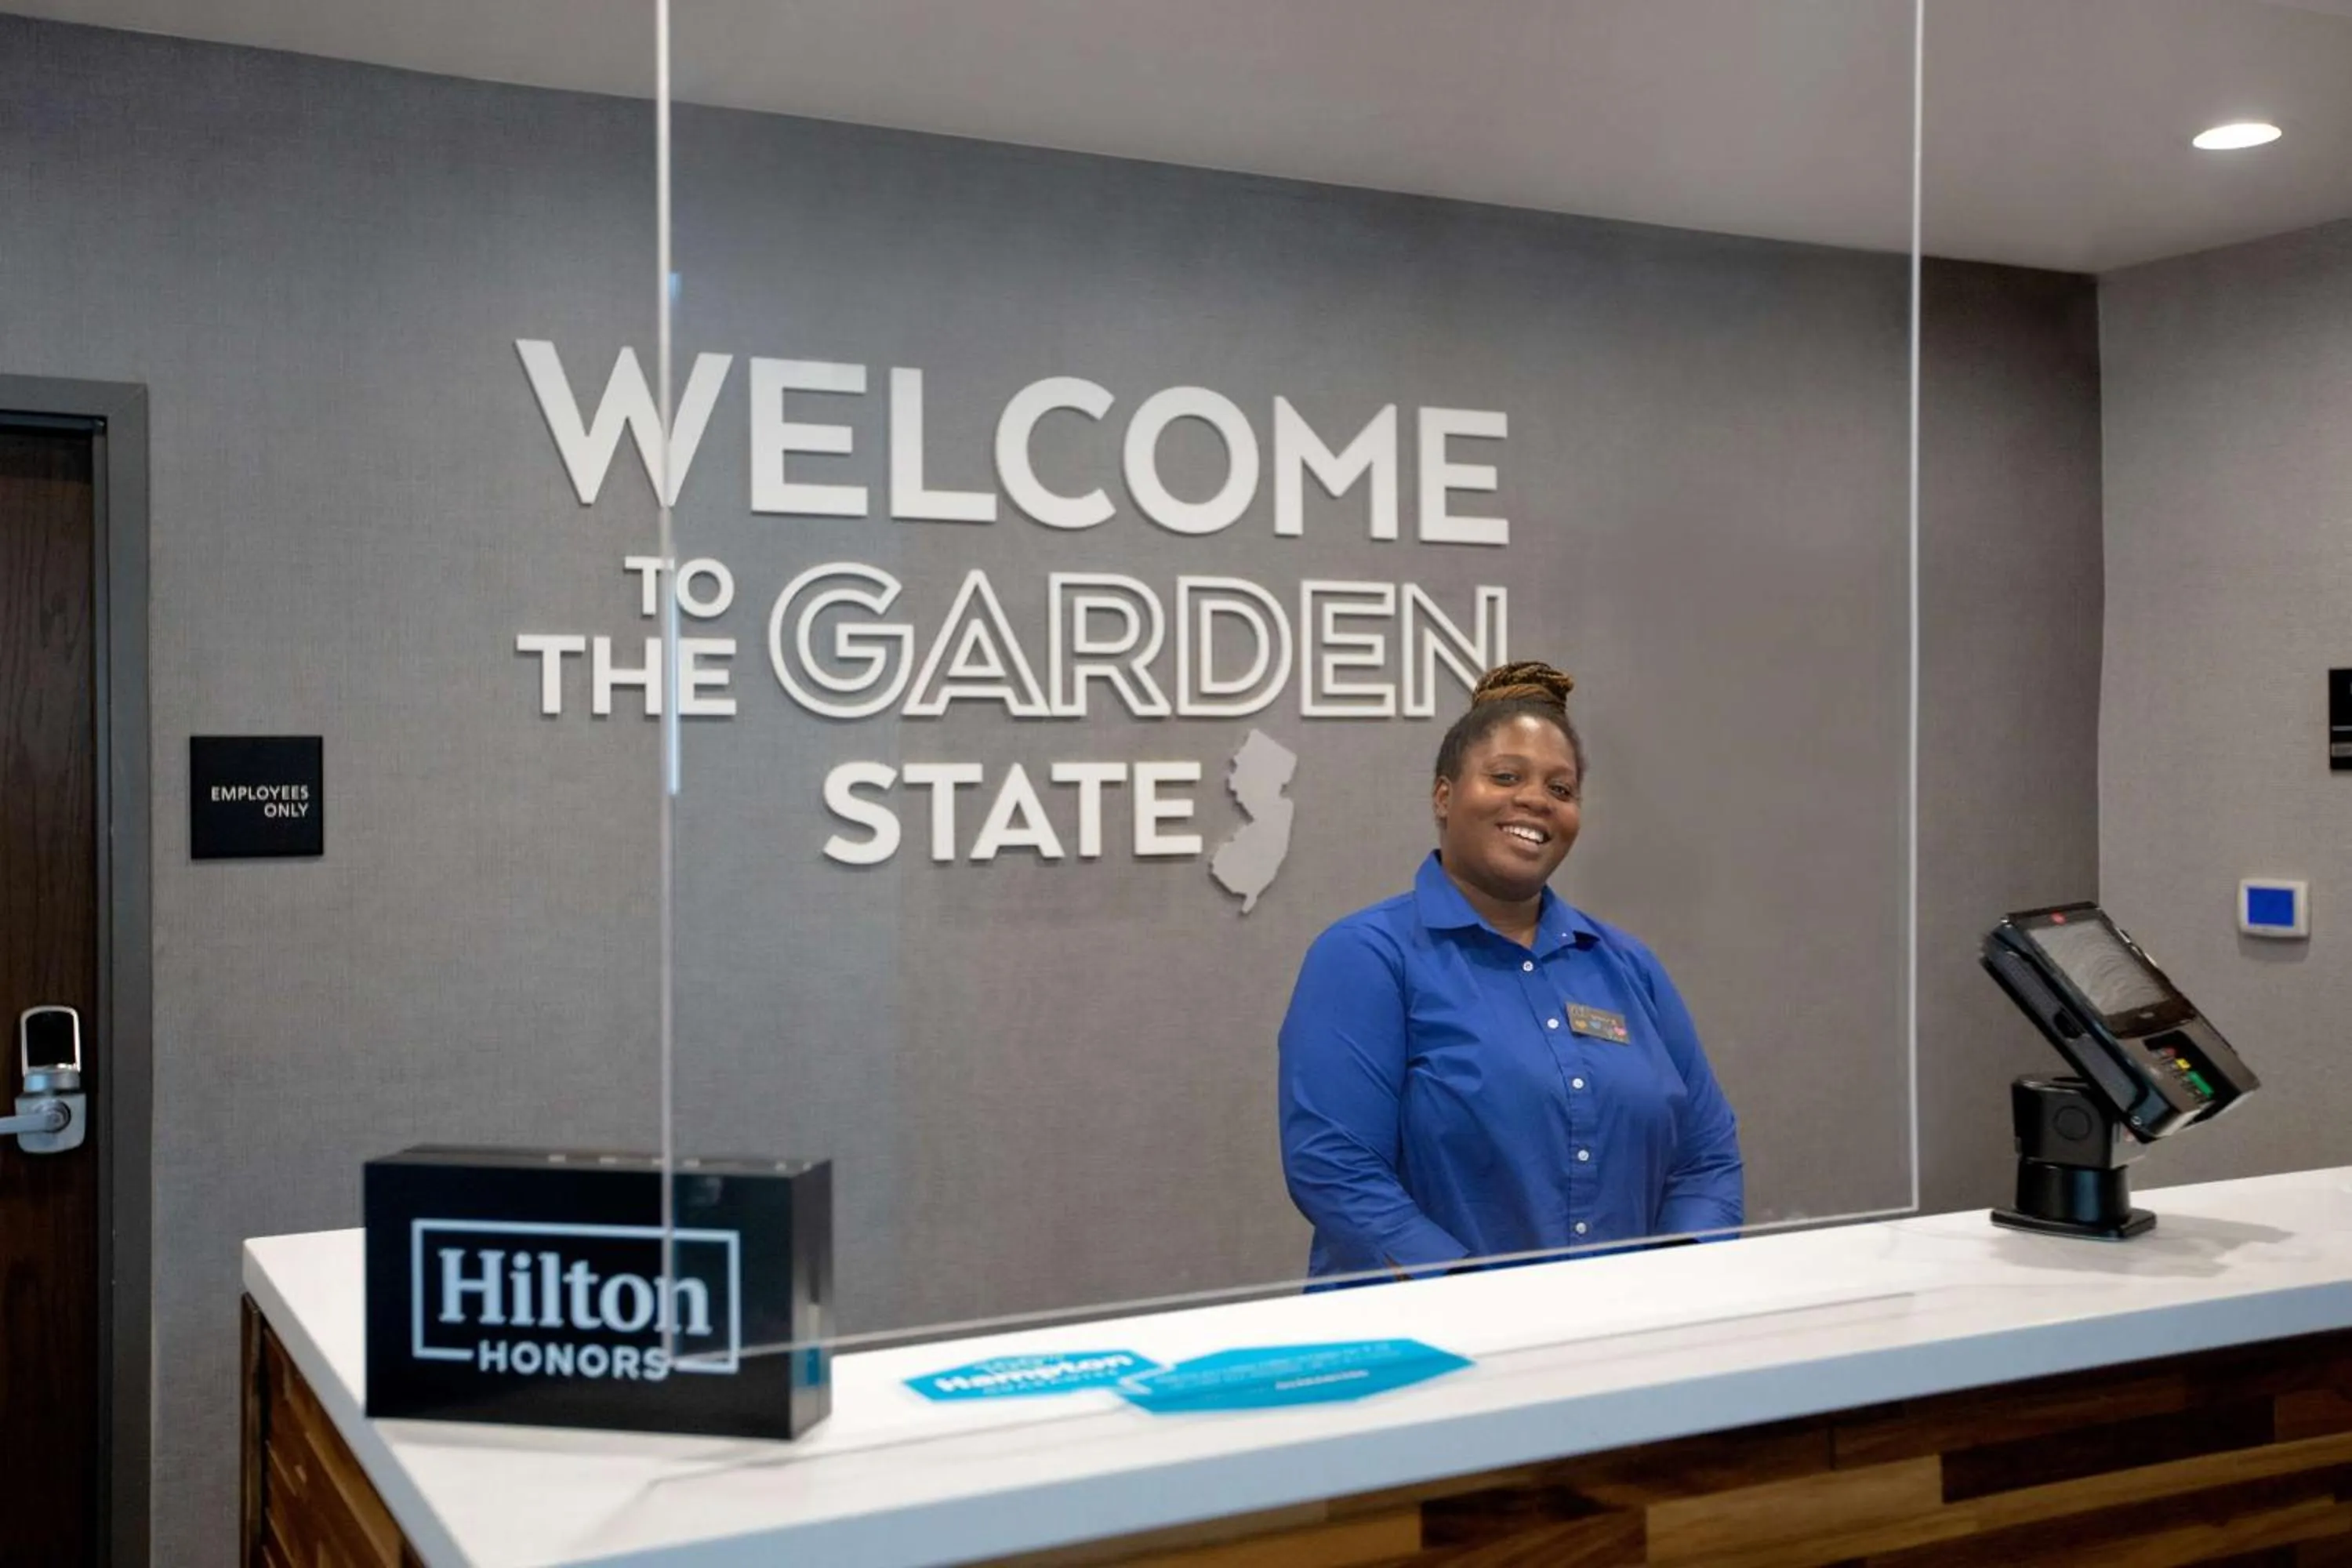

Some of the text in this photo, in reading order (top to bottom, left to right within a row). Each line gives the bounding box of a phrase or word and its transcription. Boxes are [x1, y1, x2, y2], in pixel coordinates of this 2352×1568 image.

[515, 338, 1509, 544] WELCOME
[625, 556, 735, 618] TO
[517, 562, 1507, 718] THE GARDEN
[210, 785, 310, 801] EMPLOYEES
[264, 802, 309, 818] ONLY
[822, 761, 1203, 865] STATE
[437, 1248, 712, 1336] Hilton
[478, 1340, 670, 1381] HONORS
